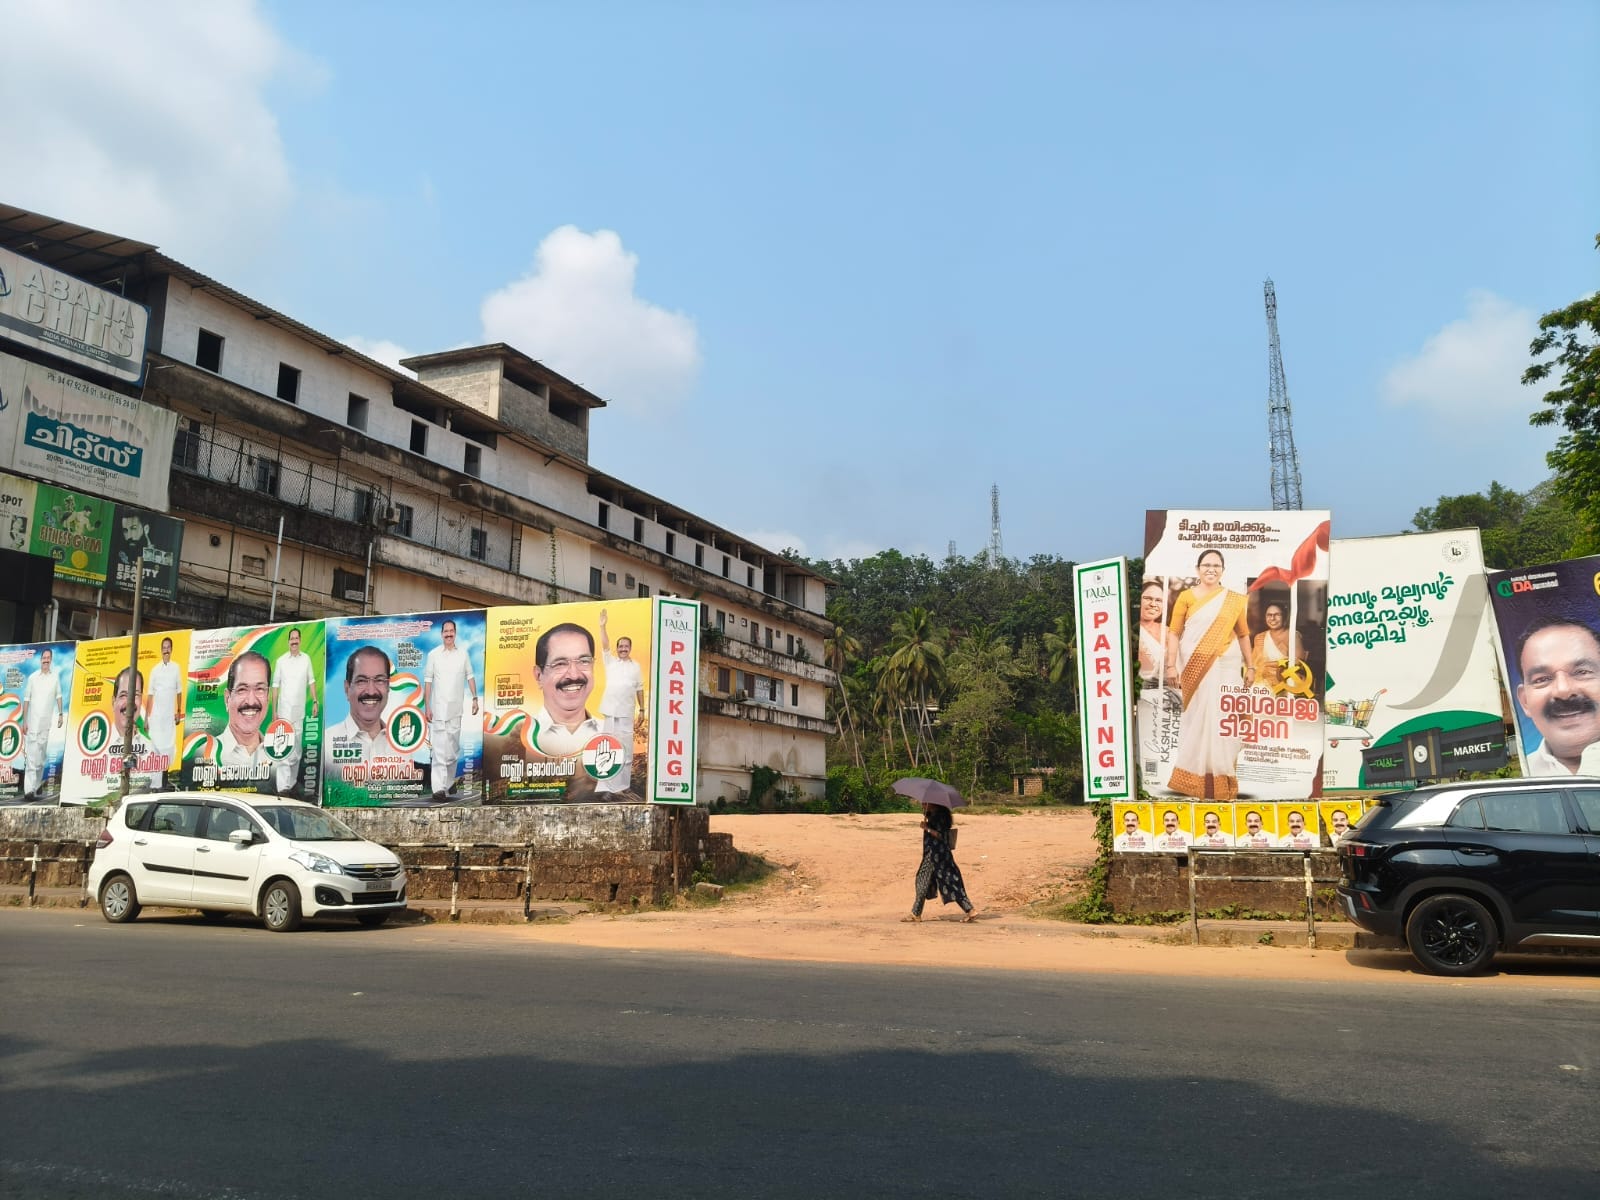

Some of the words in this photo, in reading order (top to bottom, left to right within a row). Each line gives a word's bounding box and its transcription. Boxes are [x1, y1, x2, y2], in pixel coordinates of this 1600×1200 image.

[17, 292, 134, 357] CHITS
[60, 336, 85, 350] PRIVATE
[86, 345, 109, 359] LIMITED
[1, 494, 23, 507] SPOT
[1178, 518, 1210, 533] ടീച്ചർ
[40, 525, 72, 547] FITNESS
[72, 534, 102, 553] GYM
[116, 571, 145, 582] SPO
[117, 563, 159, 578] BEATY
[1381, 580, 1448, 605] മൂല്യവും
[1328, 605, 1429, 628] ണമേന്മയും
[1337, 621, 1407, 650] ഒരുമിച്ച്
[197, 684, 218, 692] UDF
[1093, 611, 1115, 769] PARKING
[666, 640, 685, 776] PARKING
[305, 716, 320, 741] UDF
[1171, 702, 1182, 750] TEACHER
[304, 743, 319, 763] for
[332, 749, 362, 758] UDF
[1453, 742, 1492, 757] MARKET
[342, 759, 369, 788] സണ്ണി
[500, 759, 524, 782] സണ്ണി
